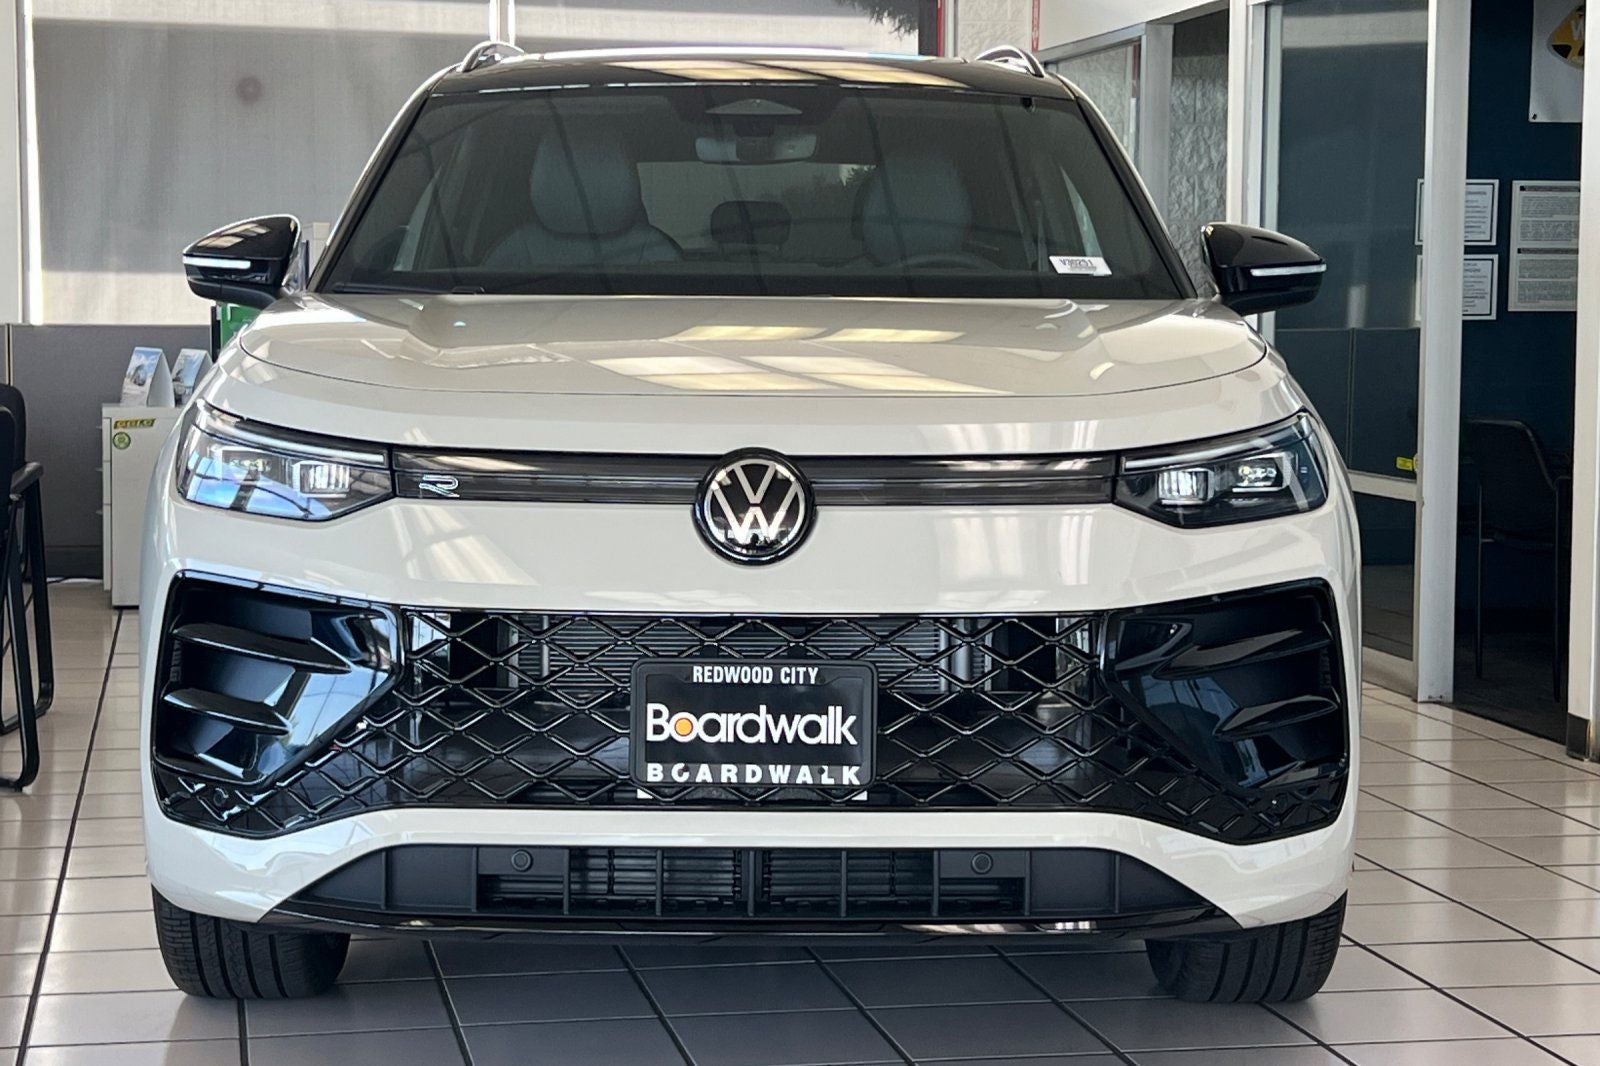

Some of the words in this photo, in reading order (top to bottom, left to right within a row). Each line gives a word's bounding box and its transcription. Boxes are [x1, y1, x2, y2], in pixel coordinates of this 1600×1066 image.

[692, 665, 774, 685] REDWOOD
[780, 666, 819, 685] CITY
[646, 702, 859, 746] Boardwalk
[646, 762, 861, 786] BOARDWALK
